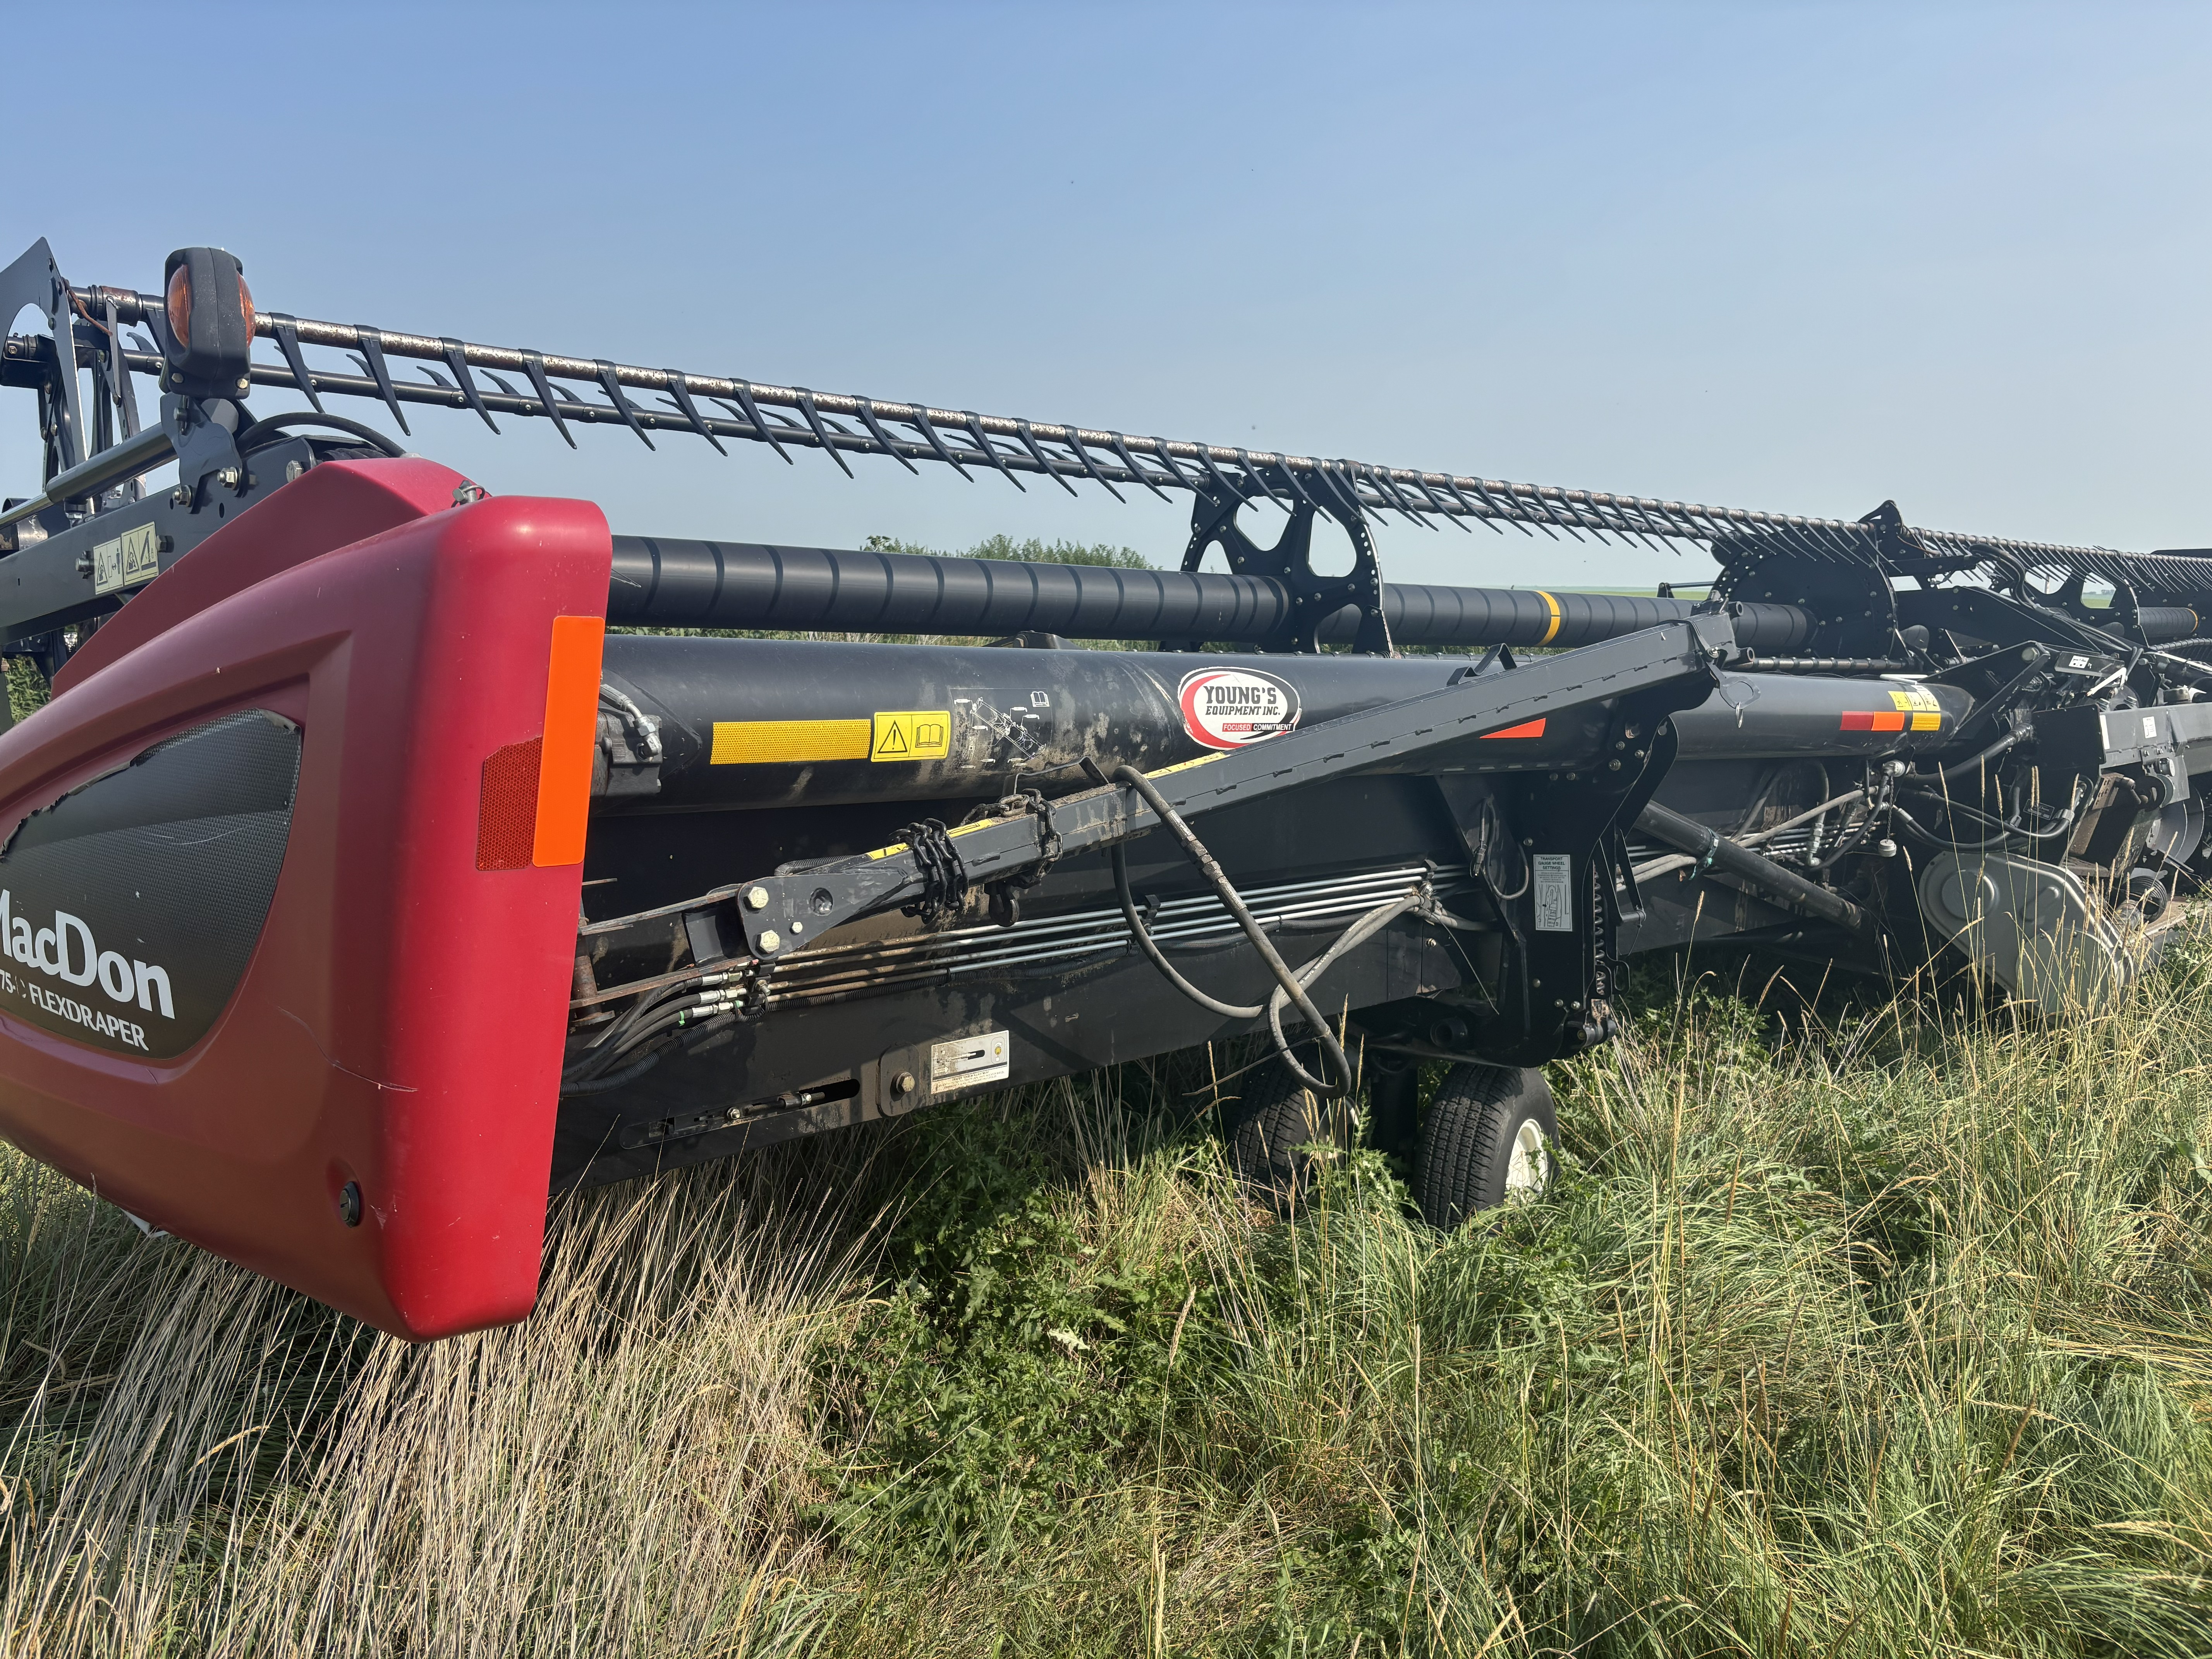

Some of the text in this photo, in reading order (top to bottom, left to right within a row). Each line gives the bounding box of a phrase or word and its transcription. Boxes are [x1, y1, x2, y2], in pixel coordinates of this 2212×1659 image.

[1203, 686, 1277, 704] YOUNG'S
[1205, 706, 1280, 715] EQUIPMENT INC.
[28, 982, 149, 1051] FLEXDRAPER
